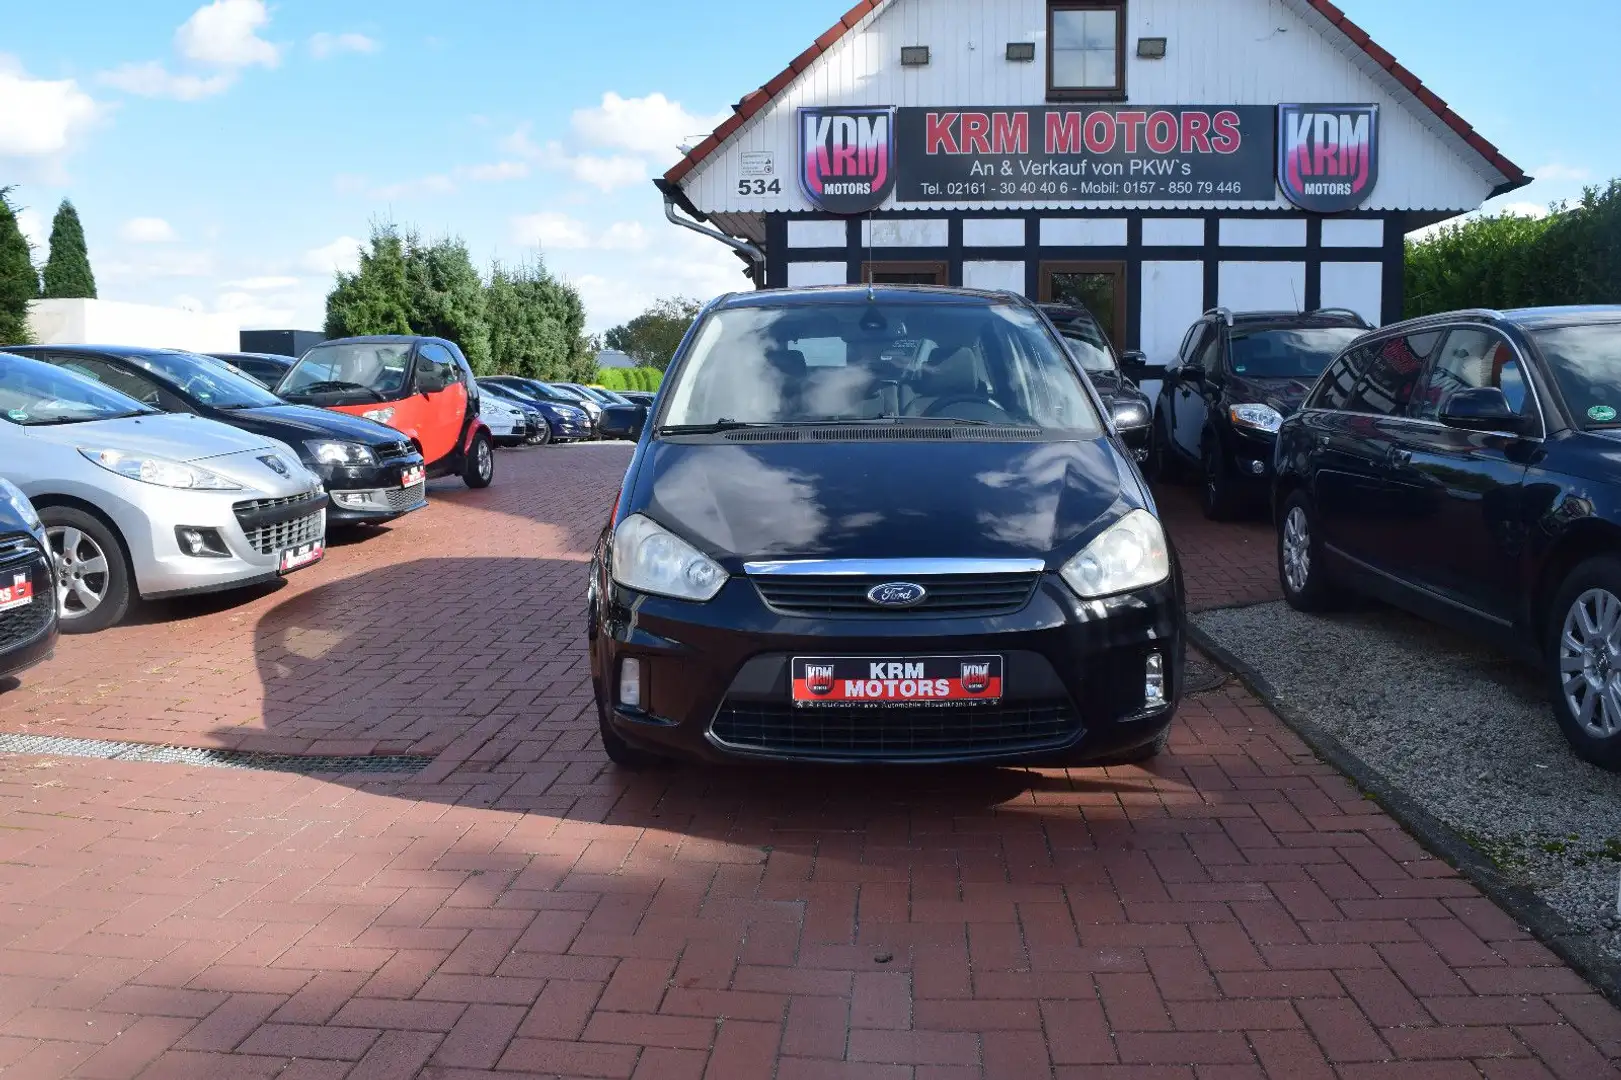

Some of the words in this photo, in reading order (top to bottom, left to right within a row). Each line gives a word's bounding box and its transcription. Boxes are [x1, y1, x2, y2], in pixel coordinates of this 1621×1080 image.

[925, 111, 1029, 155] KRM
[1044, 110, 1242, 154] MOTORS
[806, 115, 888, 179] KRM
[1287, 112, 1370, 177] KRM
[969, 160, 994, 176] An
[1000, 160, 1014, 176] &
[1018, 159, 1088, 176] Verkauf
[1091, 162, 1123, 176] von
[737, 178, 782, 196] 534
[823, 182, 871, 196] MOTORS
[920, 182, 943, 195] Tel.
[947, 182, 986, 195] 02161
[999, 182, 1016, 195] 30
[1019, 182, 1036, 194] 40
[1039, 182, 1056, 194] 40
[1059, 182, 1068, 194] 6
[1080, 181, 1119, 194] Mobil:
[1123, 181, 1156, 194] 0157
[1168, 181, 1193, 194] 850
[1196, 181, 1213, 194] 79
[1216, 181, 1242, 194] 446
[1304, 182, 1352, 196] MOTORS
[881, 587, 912, 600] Ford
[870, 662, 924, 680] KRM
[844, 679, 950, 697] MOTORS
